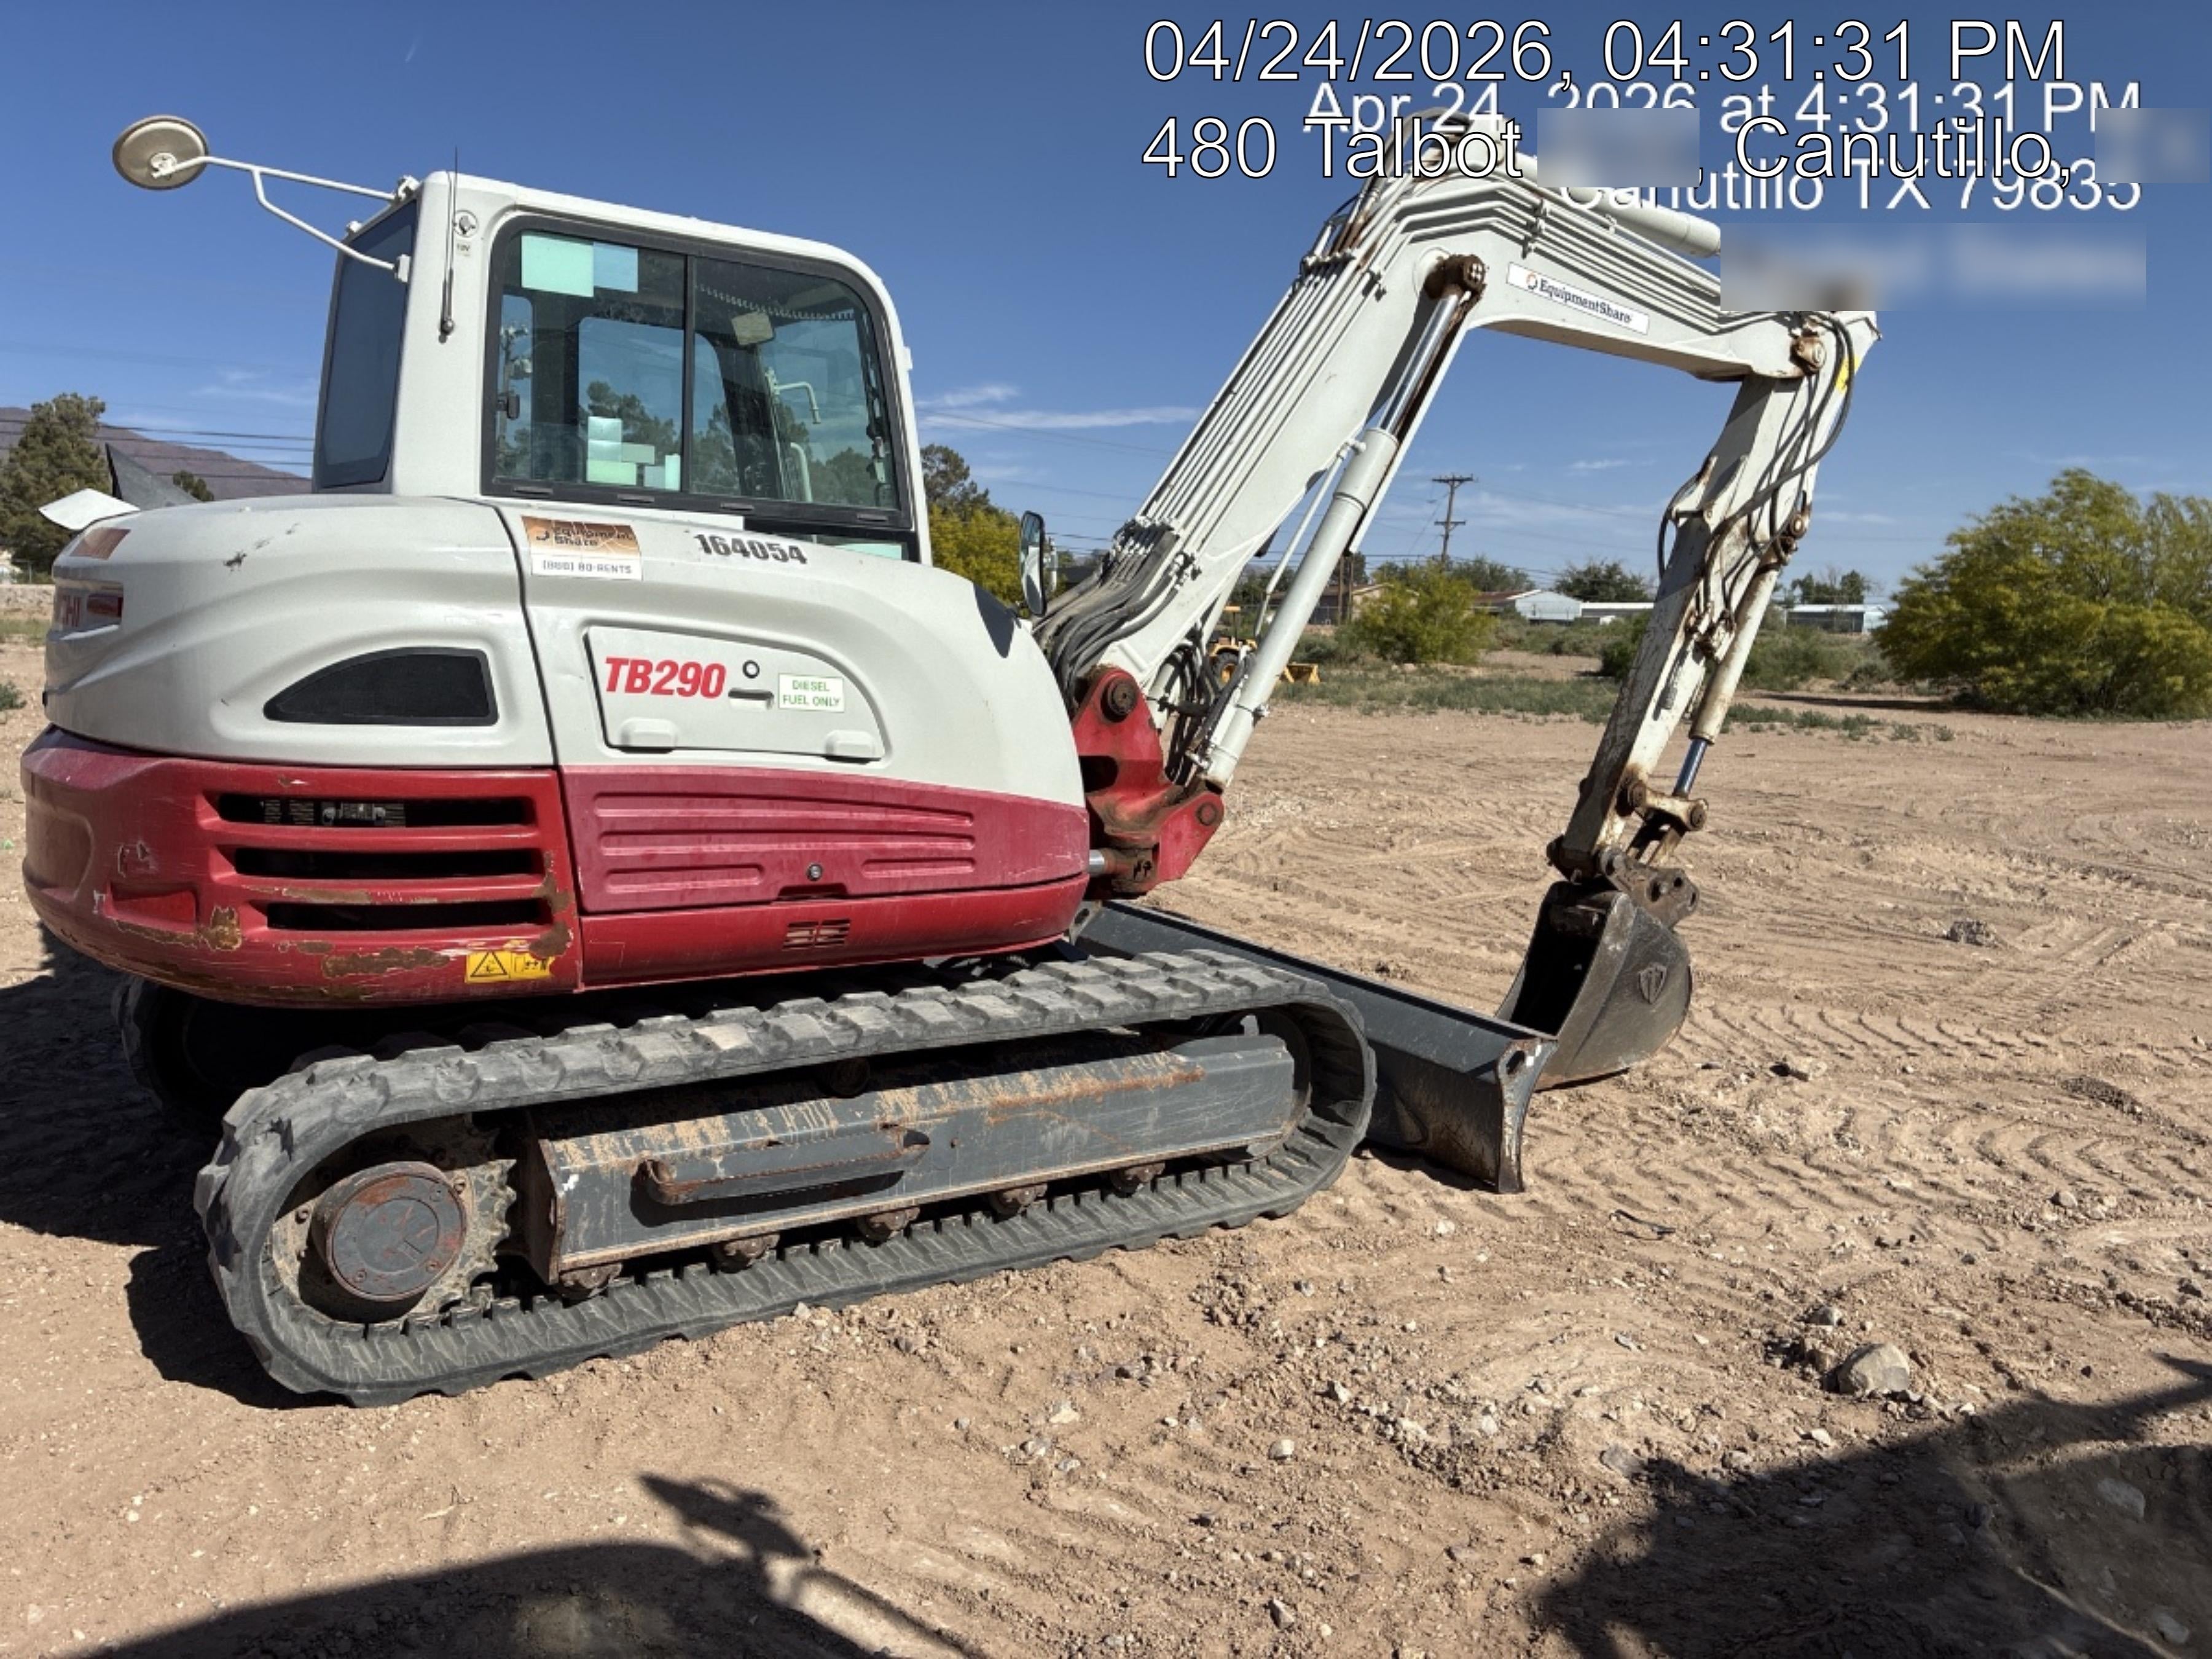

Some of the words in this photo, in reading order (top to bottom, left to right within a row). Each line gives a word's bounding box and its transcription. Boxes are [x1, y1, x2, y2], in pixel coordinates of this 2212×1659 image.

[1540, 278, 1632, 324] EquipmentShare
[694, 534, 808, 564] 164054
[605, 657, 727, 699] TB290
[792, 680, 830, 692] DIESEL
[783, 694, 810, 705] FUEL
[812, 696, 841, 707] ONLY
